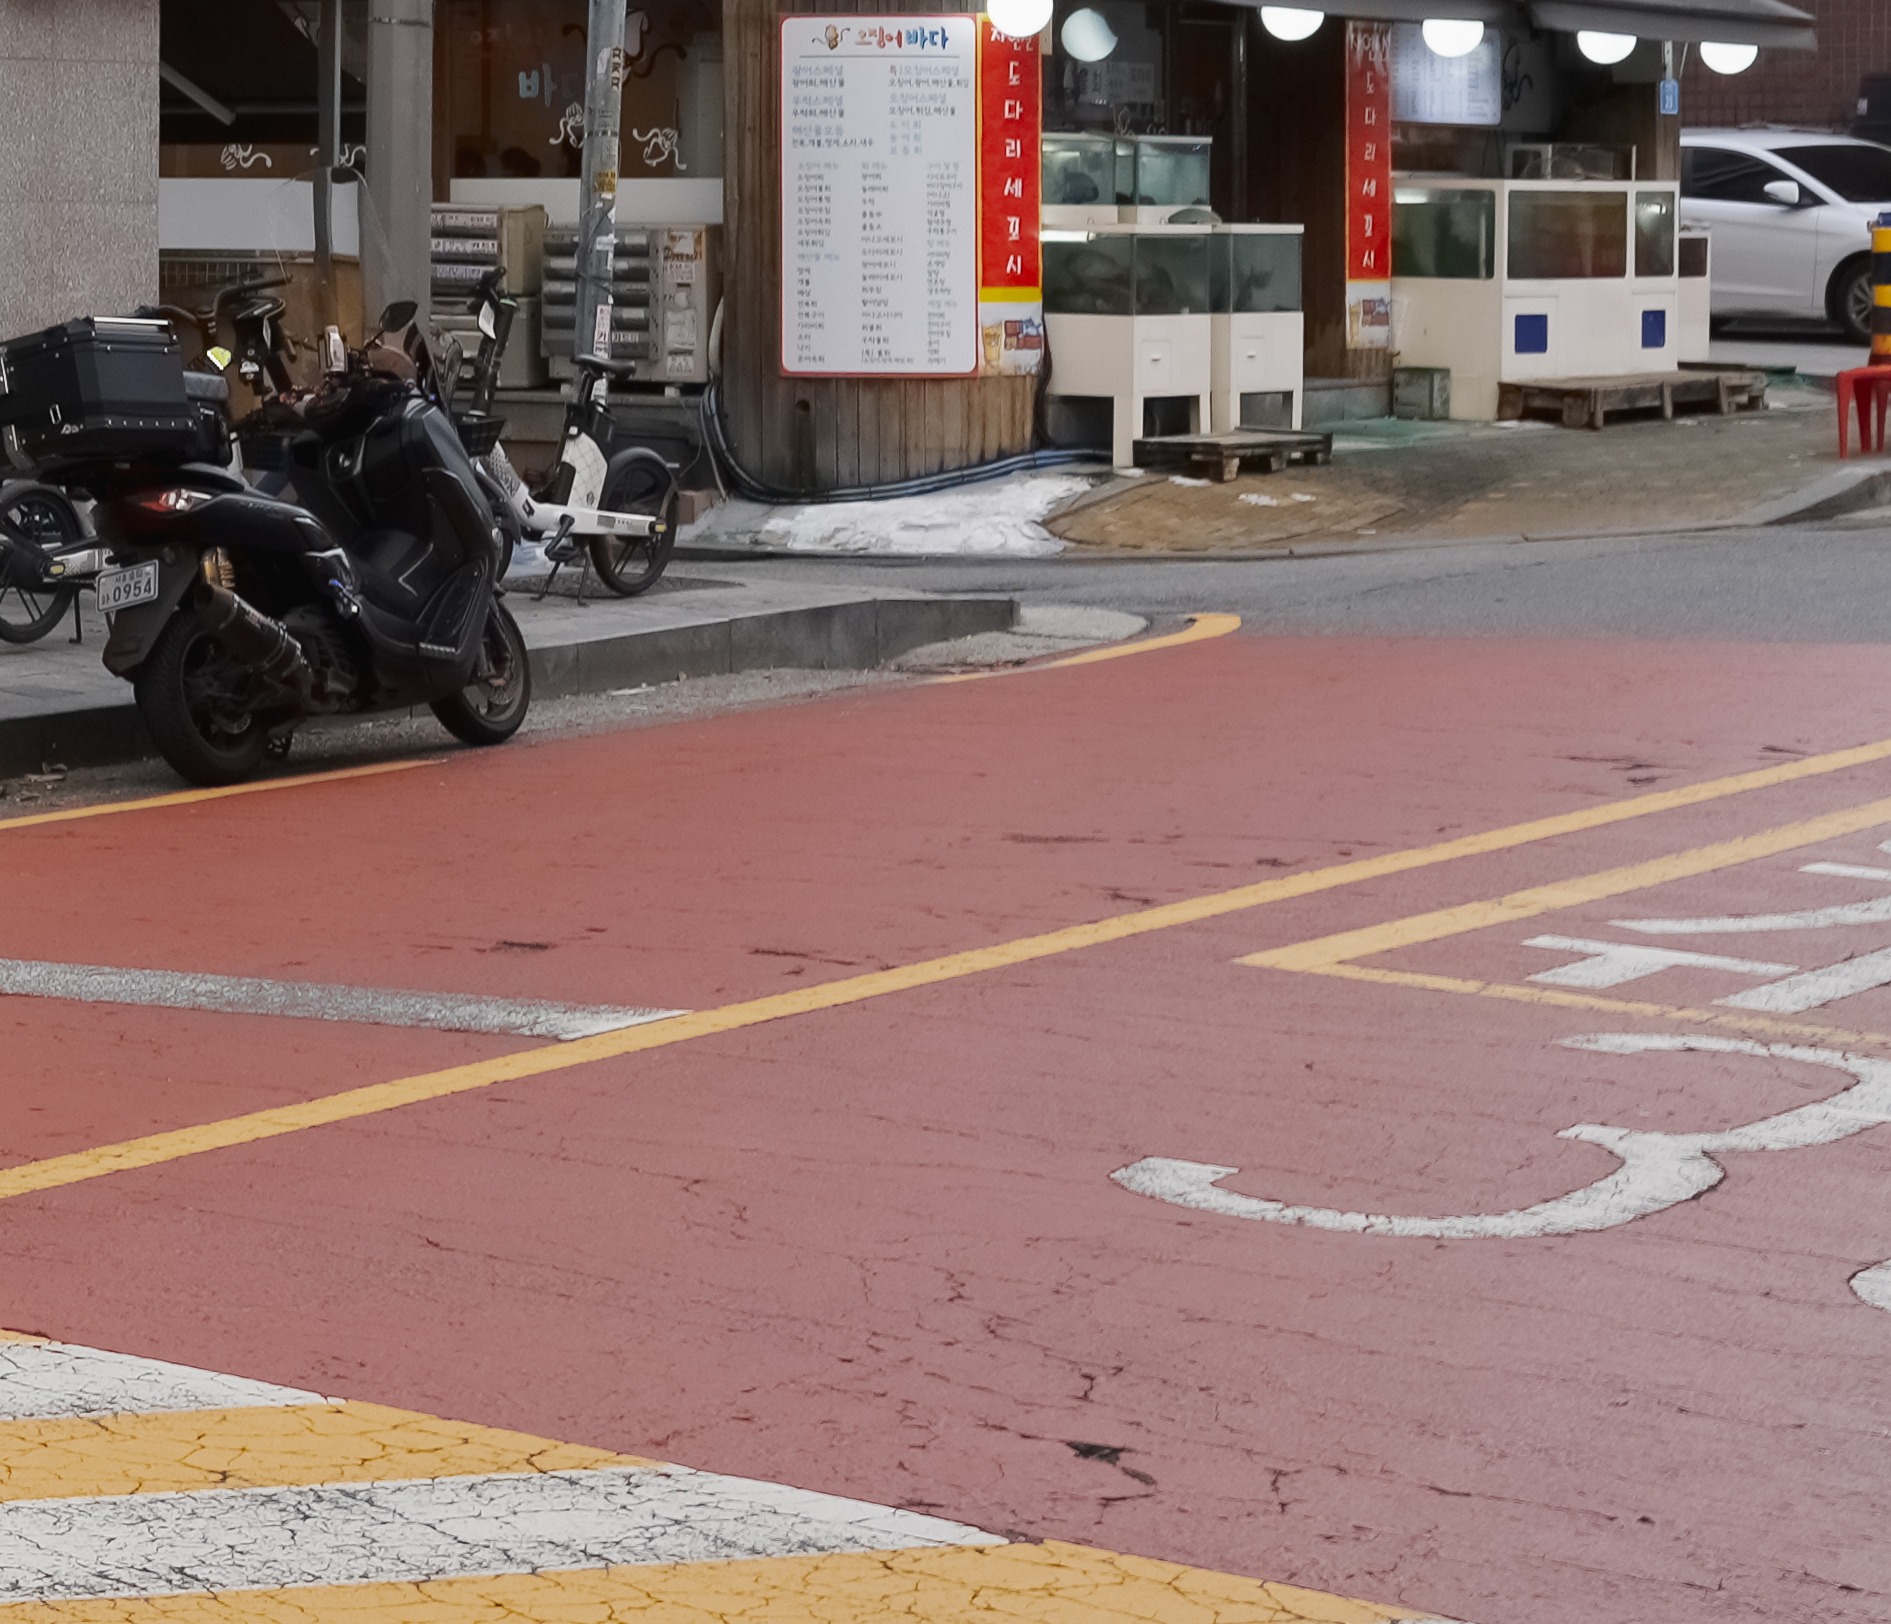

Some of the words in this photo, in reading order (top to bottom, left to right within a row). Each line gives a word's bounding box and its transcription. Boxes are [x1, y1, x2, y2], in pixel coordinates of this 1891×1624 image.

[855, 26, 903, 49] 오징어
[905, 26, 949, 50] 바다
[113, 578, 152, 602] 0954
